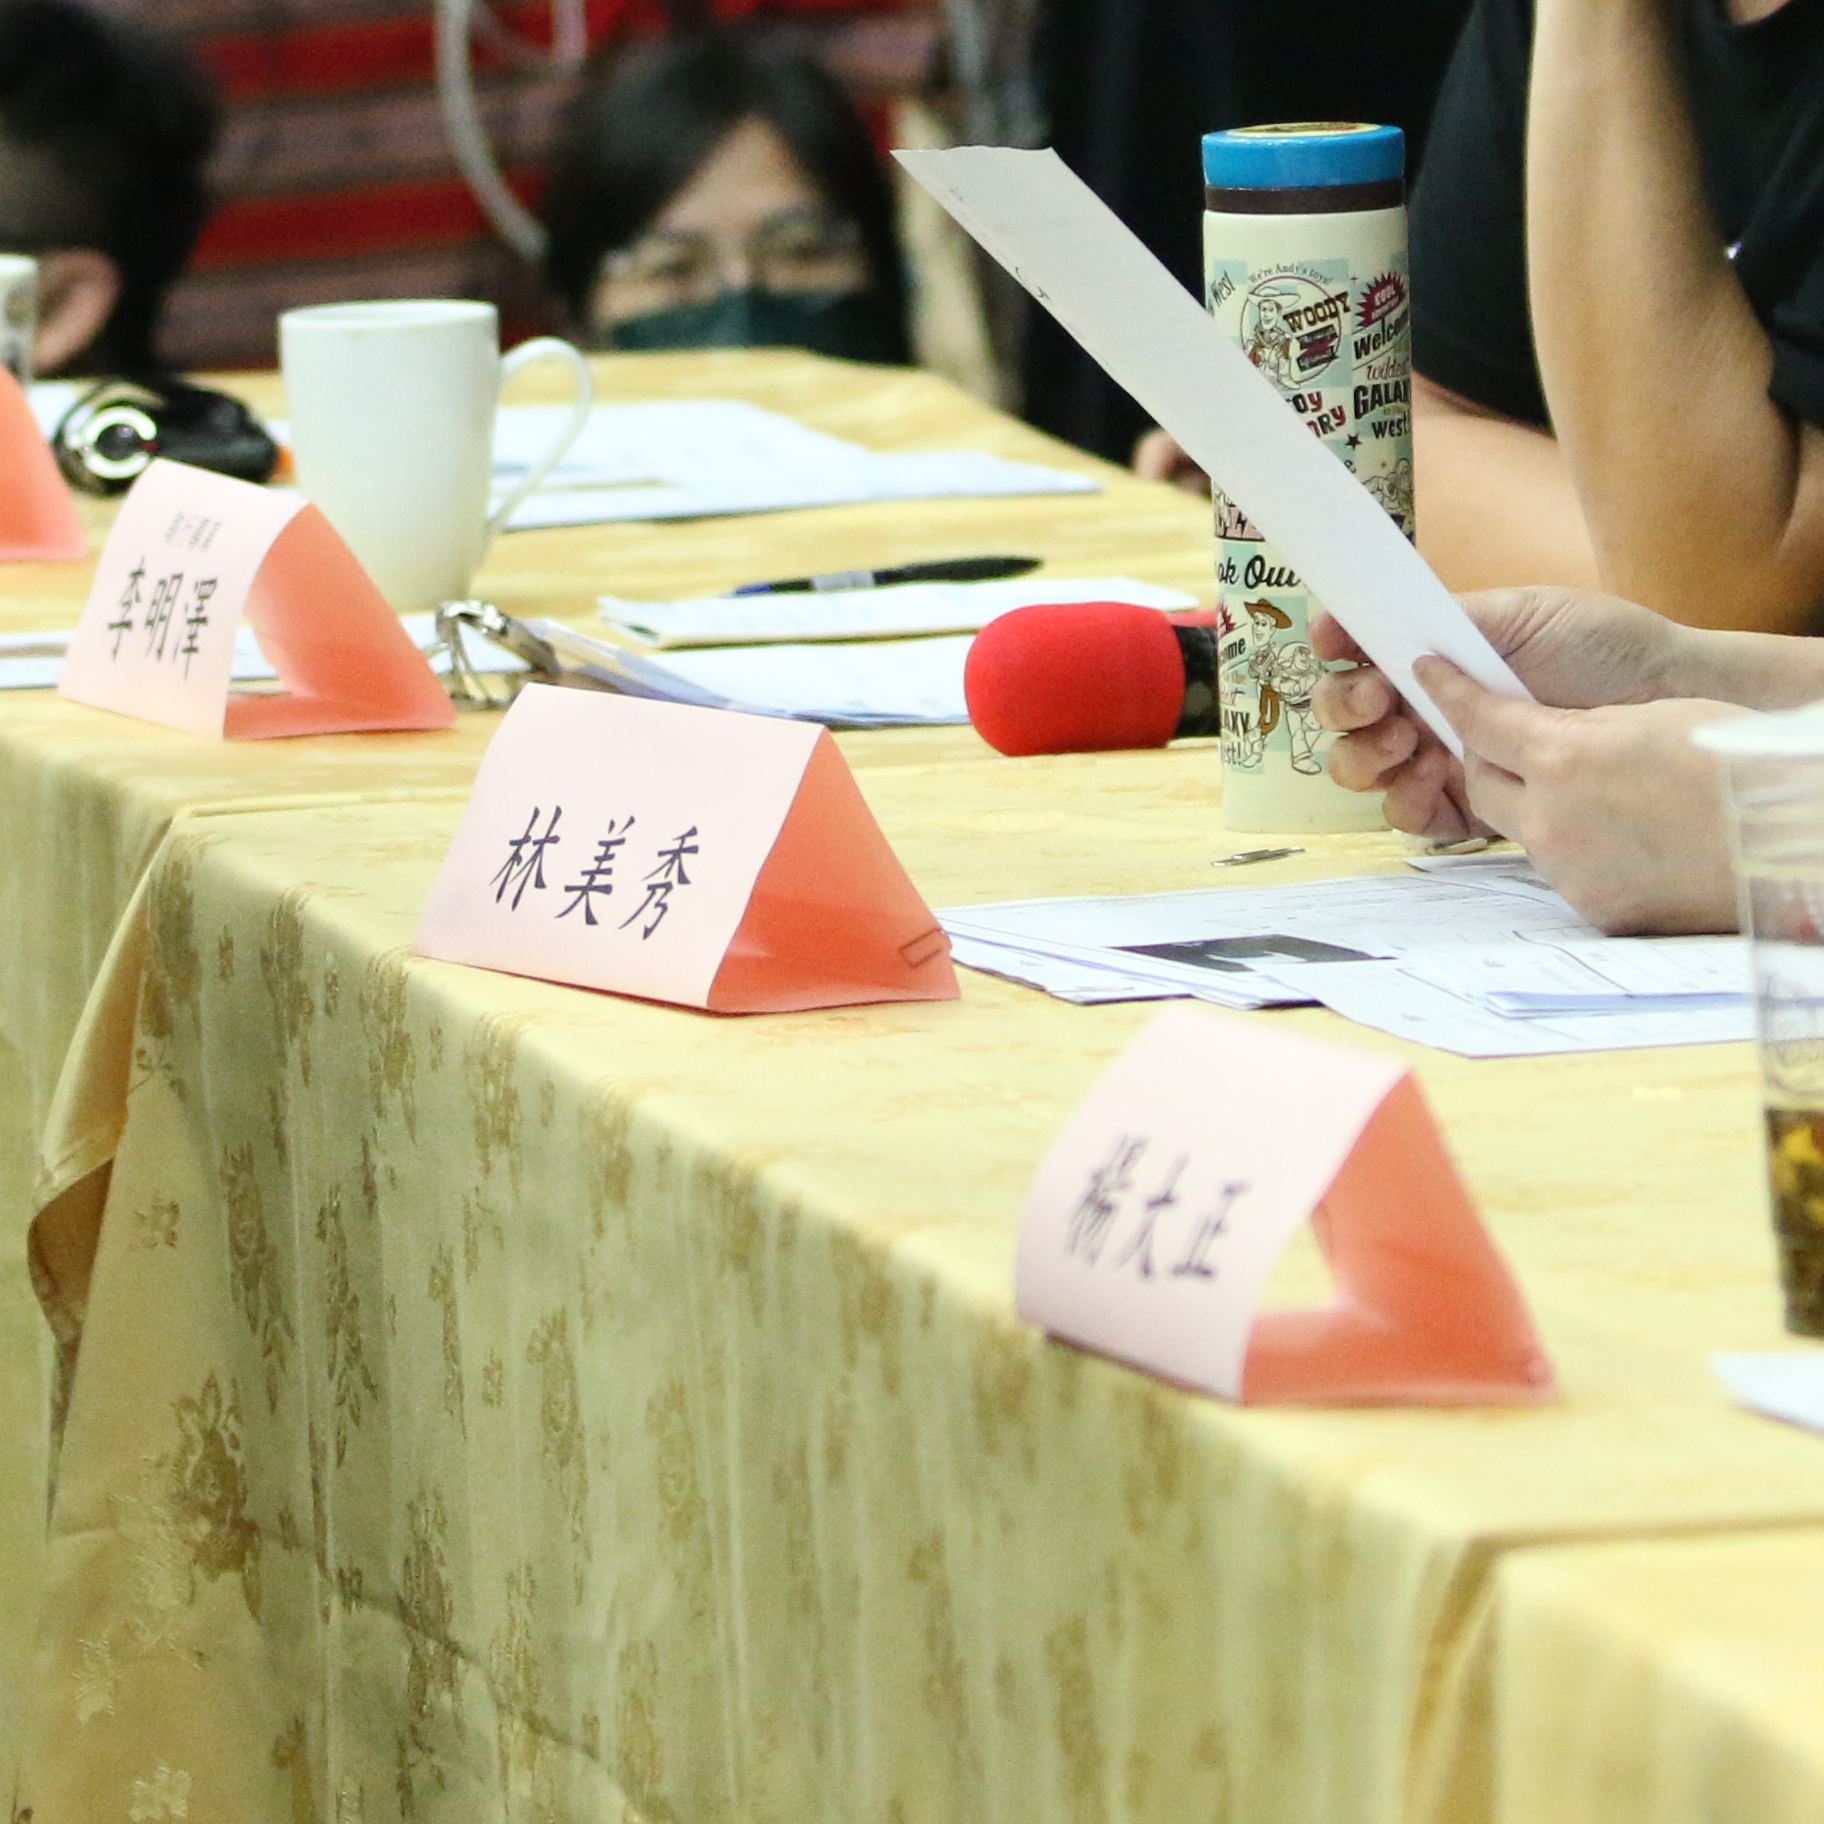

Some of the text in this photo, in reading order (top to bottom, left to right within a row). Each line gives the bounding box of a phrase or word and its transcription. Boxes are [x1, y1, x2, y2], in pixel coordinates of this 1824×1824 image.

[1283, 291, 1352, 333] WOODY
[1354, 306, 1410, 360] Welco
[1286, 391, 1323, 414] OY
[1353, 379, 1411, 420] GALA
[107, 555, 218, 680] 李明澤
[488, 805, 699, 941] 林美秀
